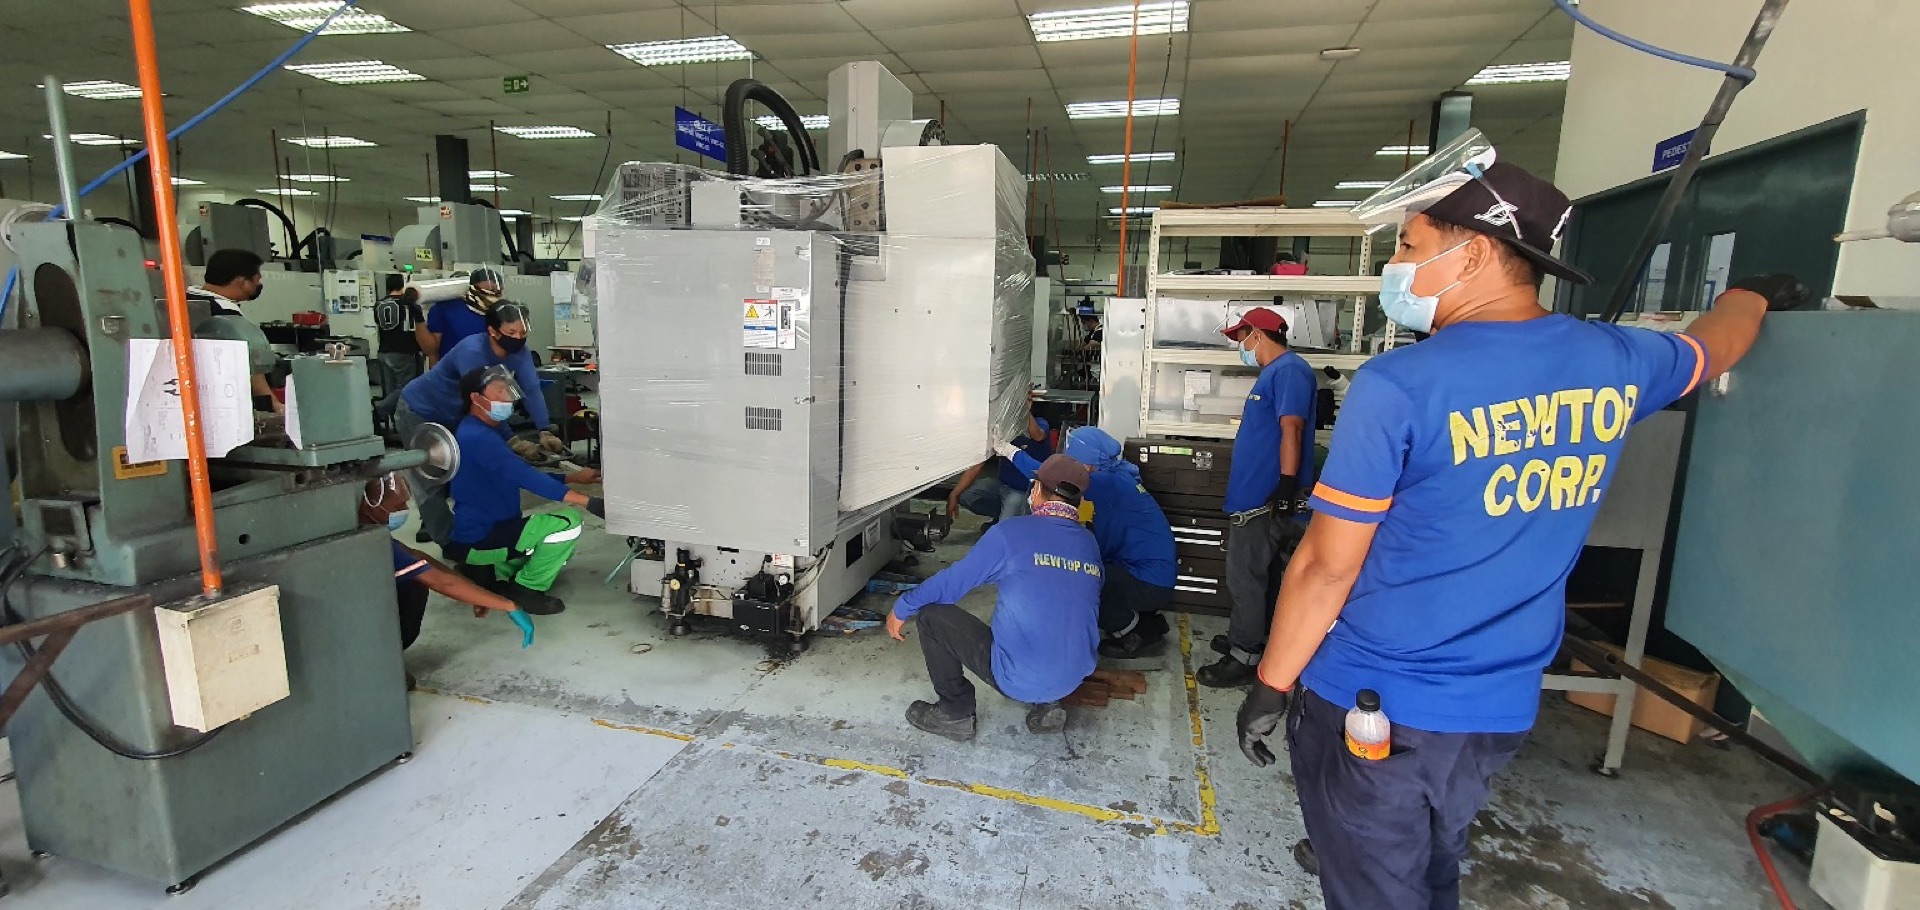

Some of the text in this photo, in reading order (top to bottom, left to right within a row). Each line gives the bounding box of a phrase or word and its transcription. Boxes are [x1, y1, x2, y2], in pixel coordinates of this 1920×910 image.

[1449, 384, 1638, 465] NEWTOP
[1483, 454, 1607, 517] CORP.
[1033, 552, 1081, 572] NEWTOP
